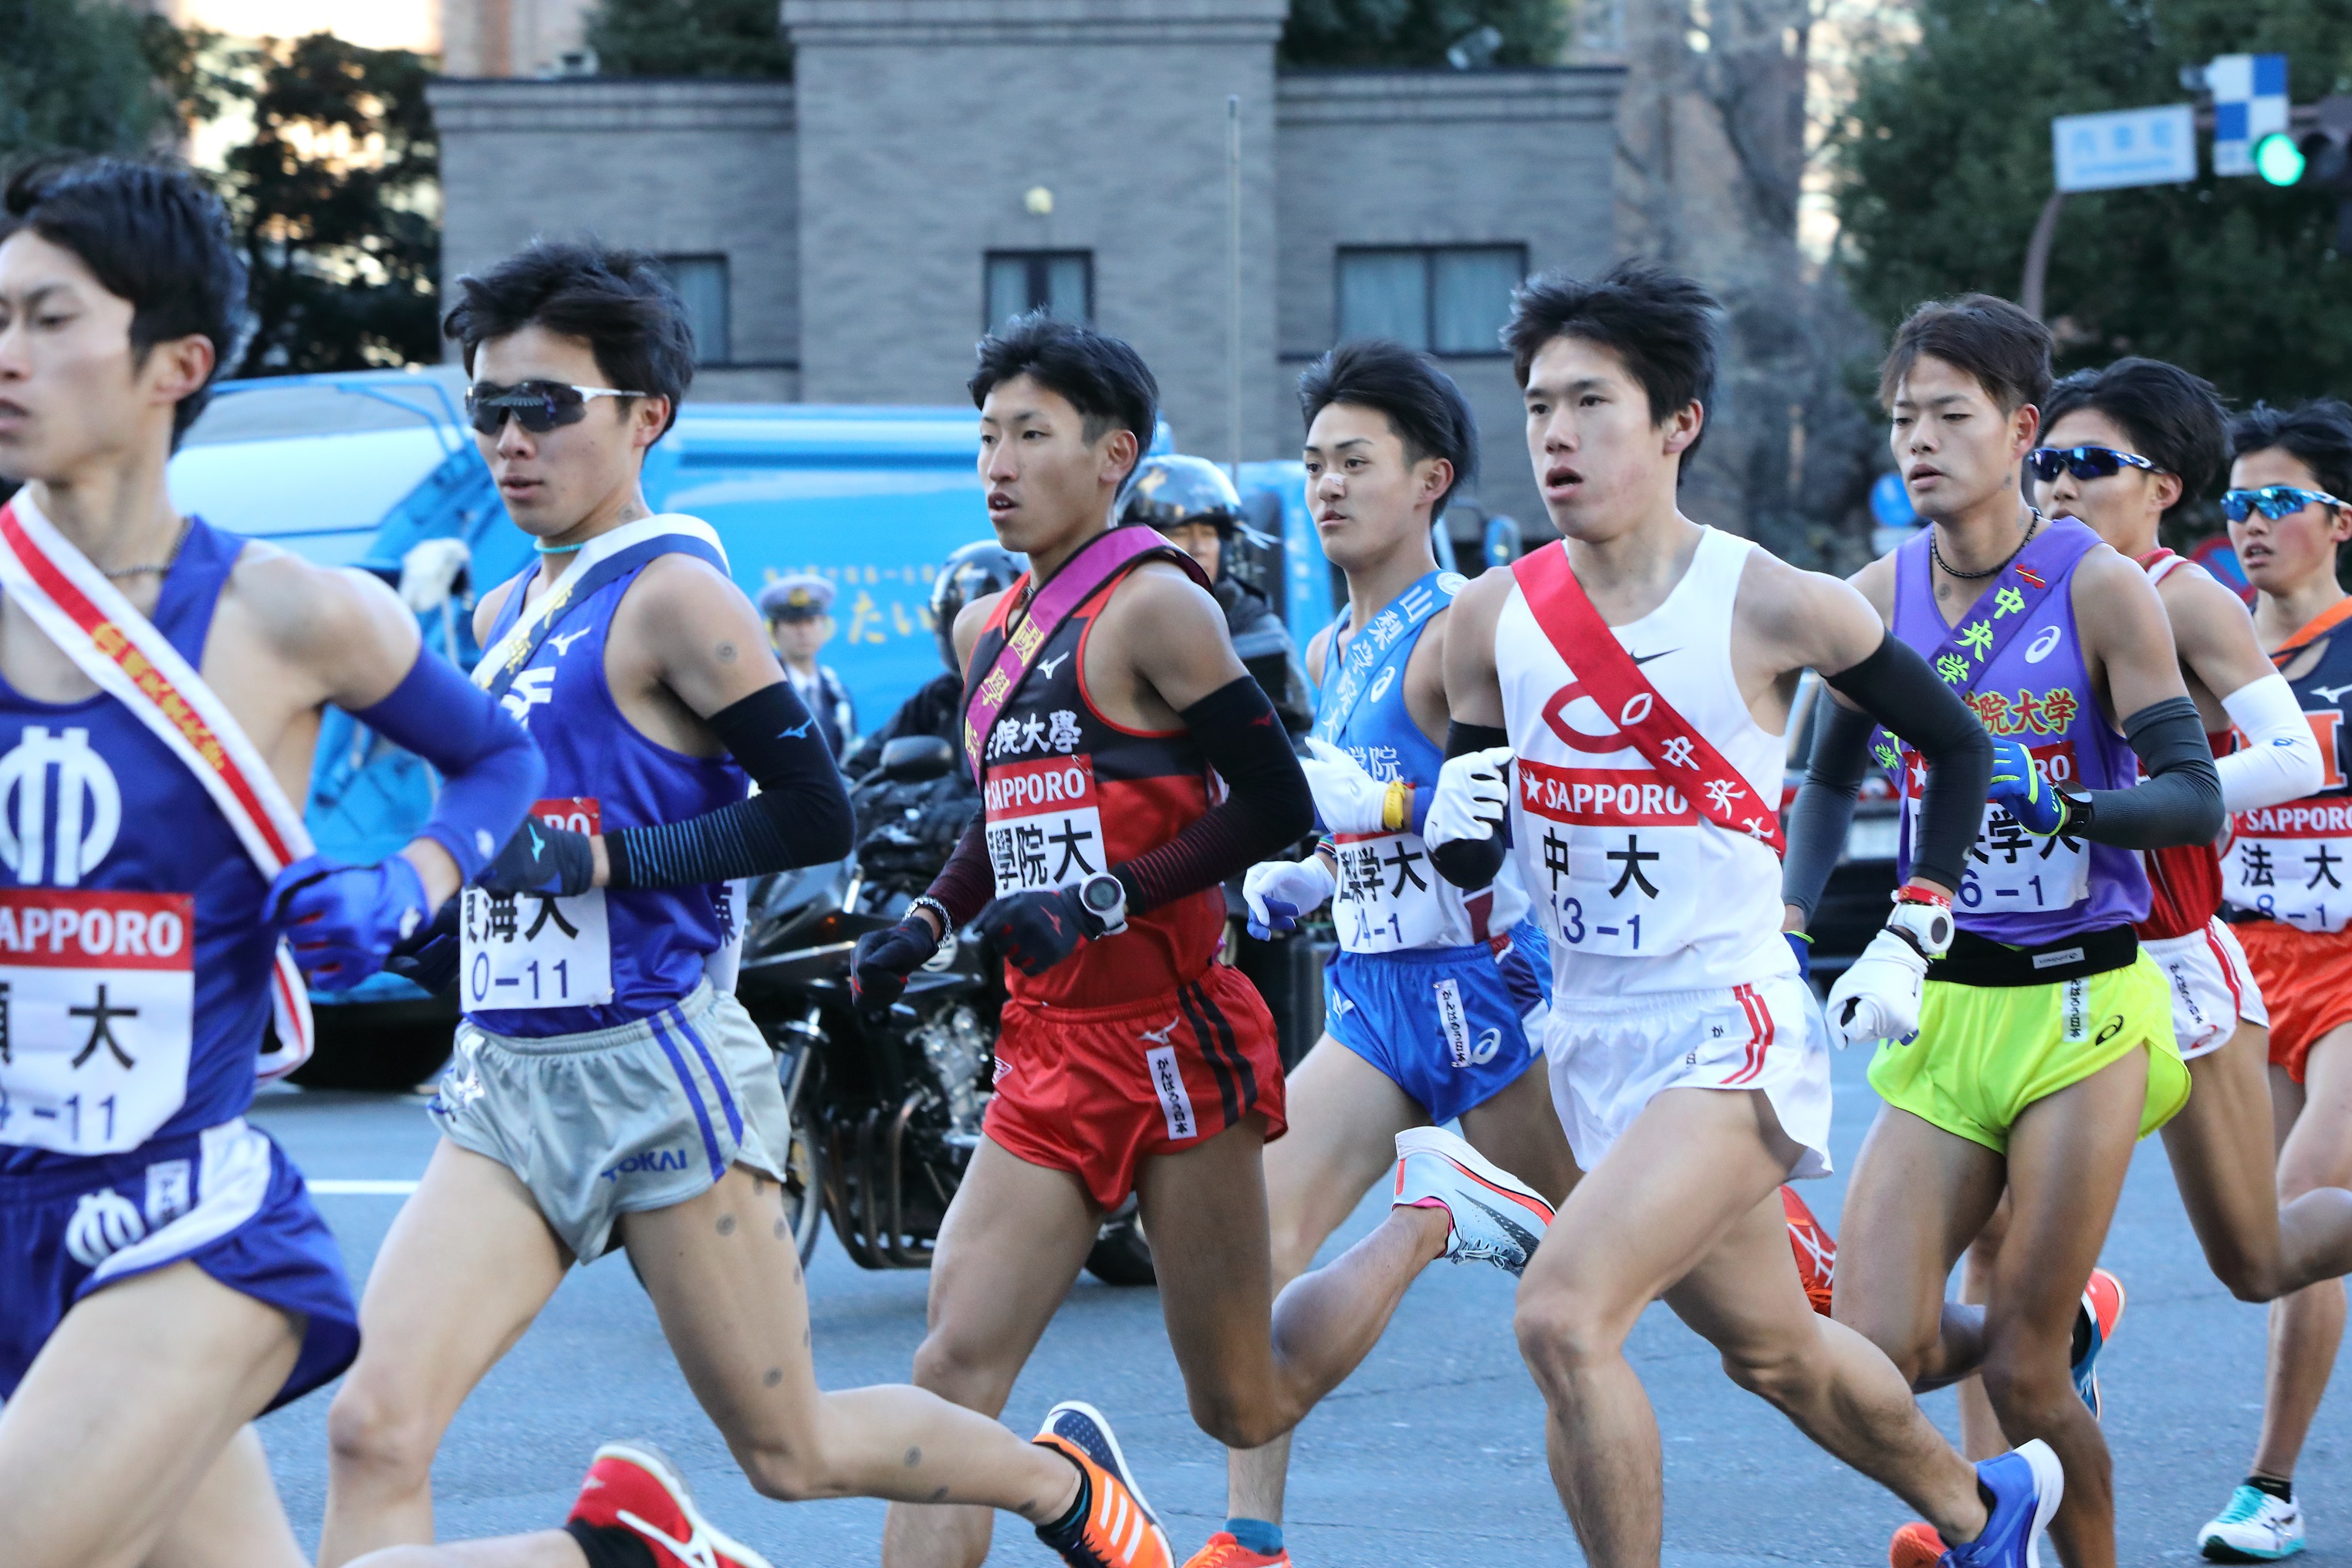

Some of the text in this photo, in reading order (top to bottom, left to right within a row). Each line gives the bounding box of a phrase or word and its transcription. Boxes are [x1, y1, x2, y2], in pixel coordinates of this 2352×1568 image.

[1315, 584, 1433, 745] 山梨学院大
[990, 767, 1086, 811] SAPPORO
[1545, 778, 1688, 815] SAPPORO
[2246, 806, 2352, 833] SAPPOR
[1543, 826, 1660, 901] 中大
[2241, 844, 2343, 890] 法大
[0, 982, 139, 1070] 大
[600, 1147, 688, 1183] TOKAI
